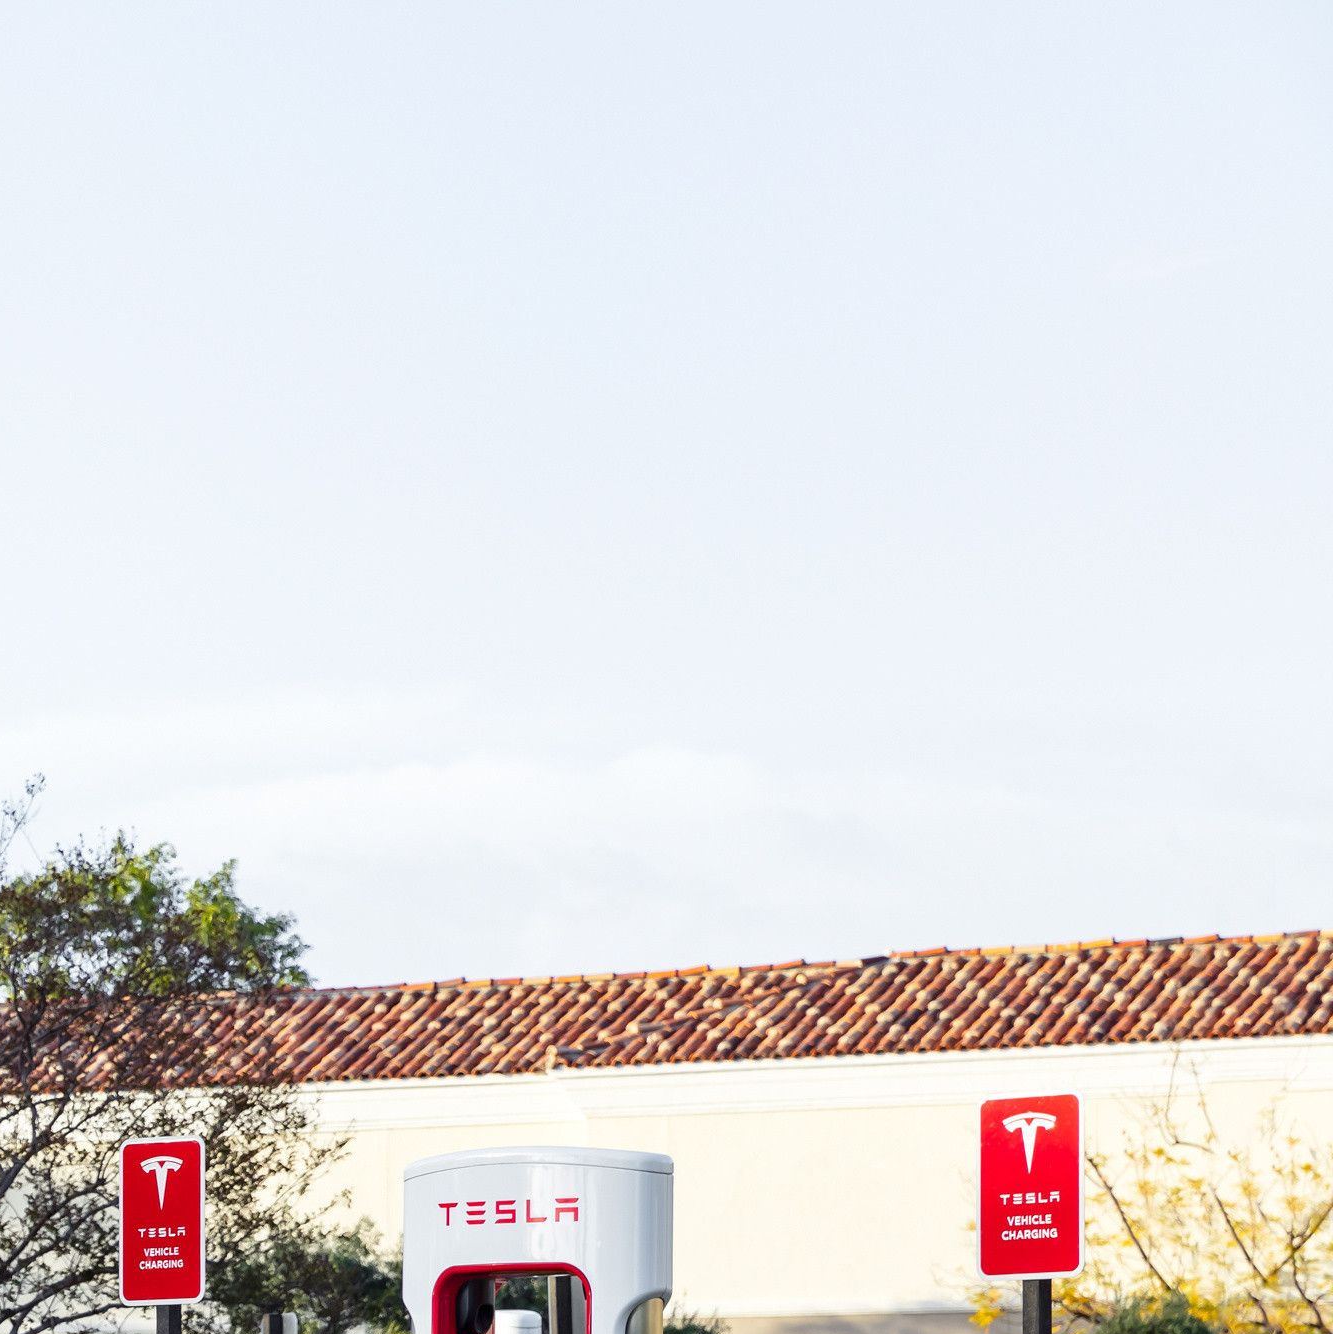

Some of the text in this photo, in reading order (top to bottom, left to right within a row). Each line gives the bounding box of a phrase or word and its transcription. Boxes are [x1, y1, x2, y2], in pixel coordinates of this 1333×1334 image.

[999, 1190, 1061, 1206] TESLA
[437, 1197, 580, 1227] TESLA
[1006, 1213, 1052, 1227] VEHICLE
[137, 1226, 186, 1238] TESLA
[1001, 1227, 1059, 1241] CHARGING
[143, 1246, 180, 1257] VEHICLE
[139, 1259, 184, 1270] CHARGING
